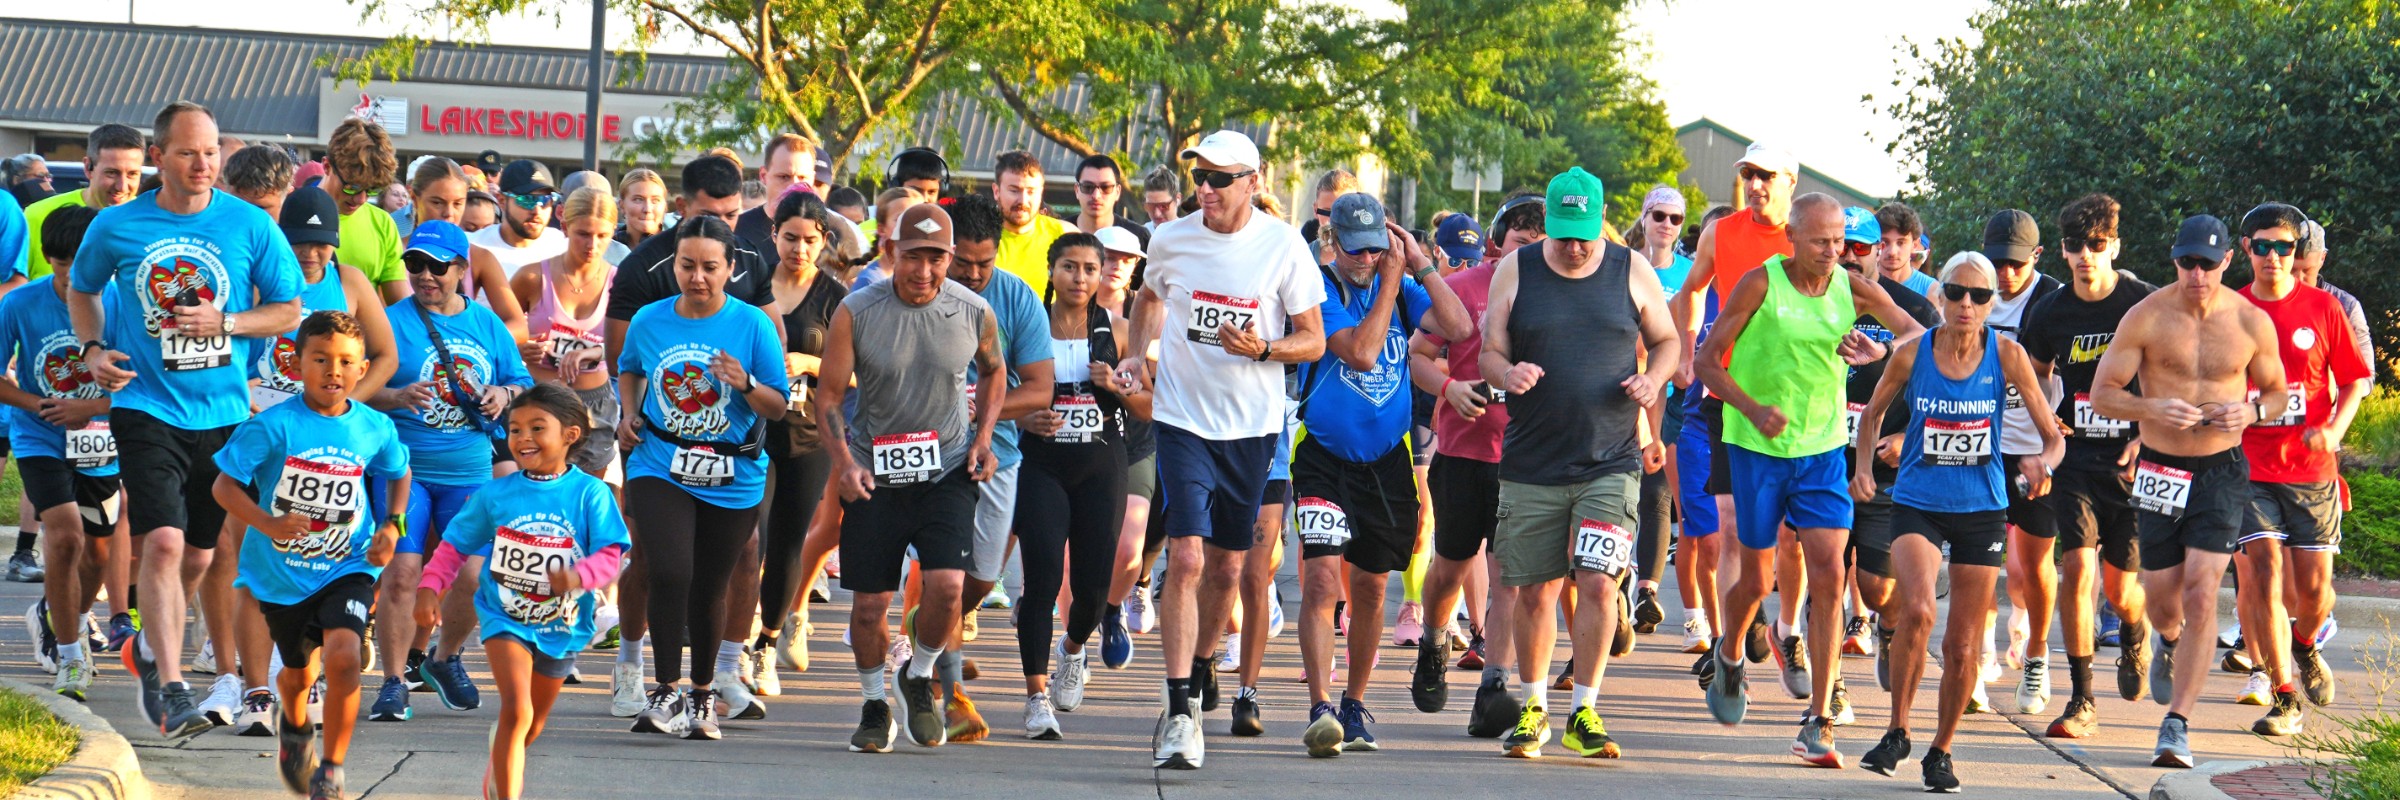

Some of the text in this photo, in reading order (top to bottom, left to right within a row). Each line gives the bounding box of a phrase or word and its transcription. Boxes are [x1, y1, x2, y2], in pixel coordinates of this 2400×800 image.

[179, 236, 190, 245] Up
[1226, 296, 1254, 305] TIME
[1194, 305, 1253, 331] 1837
[166, 333, 226, 354] 1790
[690, 342, 699, 350] Up
[1346, 370, 1385, 383] SEPTEMBER
[1938, 399, 1997, 415] RUNNING
[663, 406, 730, 437] Step Up
[1054, 408, 1100, 429] 758
[1960, 420, 1986, 428] TIME
[905, 431, 932, 440] TIME
[71, 434, 117, 454] 1806
[1928, 432, 1987, 453] 1737
[327, 445, 339, 455] Up
[679, 451, 729, 476] 1771
[878, 445, 936, 471] 1831
[327, 464, 358, 473] TIME
[905, 471, 917, 479] FOR
[287, 473, 353, 507] 1819
[2138, 474, 2186, 502] 1827
[290, 502, 326, 514] SCAN FOR
[535, 512, 547, 520] Up
[1299, 510, 1349, 533] 1794
[534, 536, 568, 545] TIME
[1580, 532, 1628, 562] 1793
[498, 544, 566, 576] 1820
[1581, 561, 1606, 571] RESULTS
[503, 575, 538, 587] SCAN FOR
[503, 581, 534, 593] RESULTS
